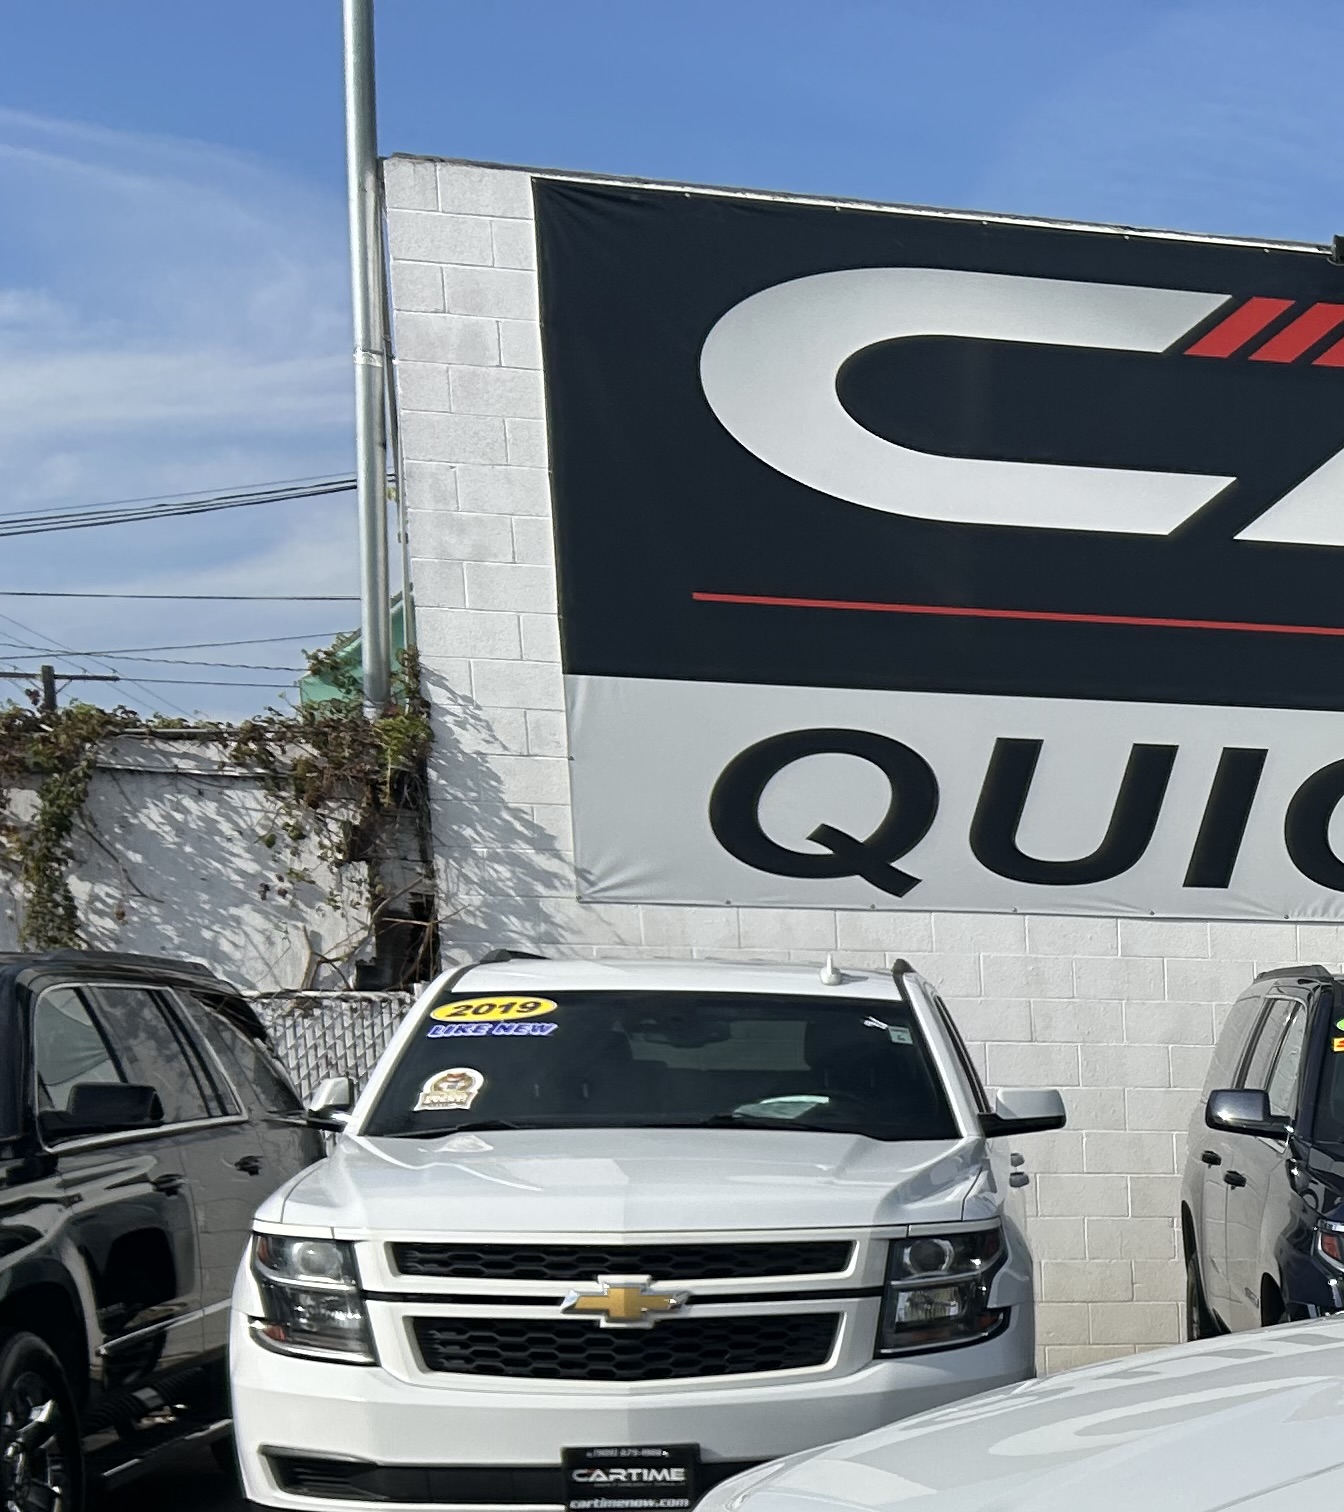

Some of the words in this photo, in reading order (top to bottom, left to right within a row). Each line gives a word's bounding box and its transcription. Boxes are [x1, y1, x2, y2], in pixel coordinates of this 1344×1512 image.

[445, 1000, 542, 1018] 2019
[428, 1024, 491, 1037] LIKE
[492, 1022, 558, 1036] NEW
[571, 1467, 686, 1482] CARTIME
